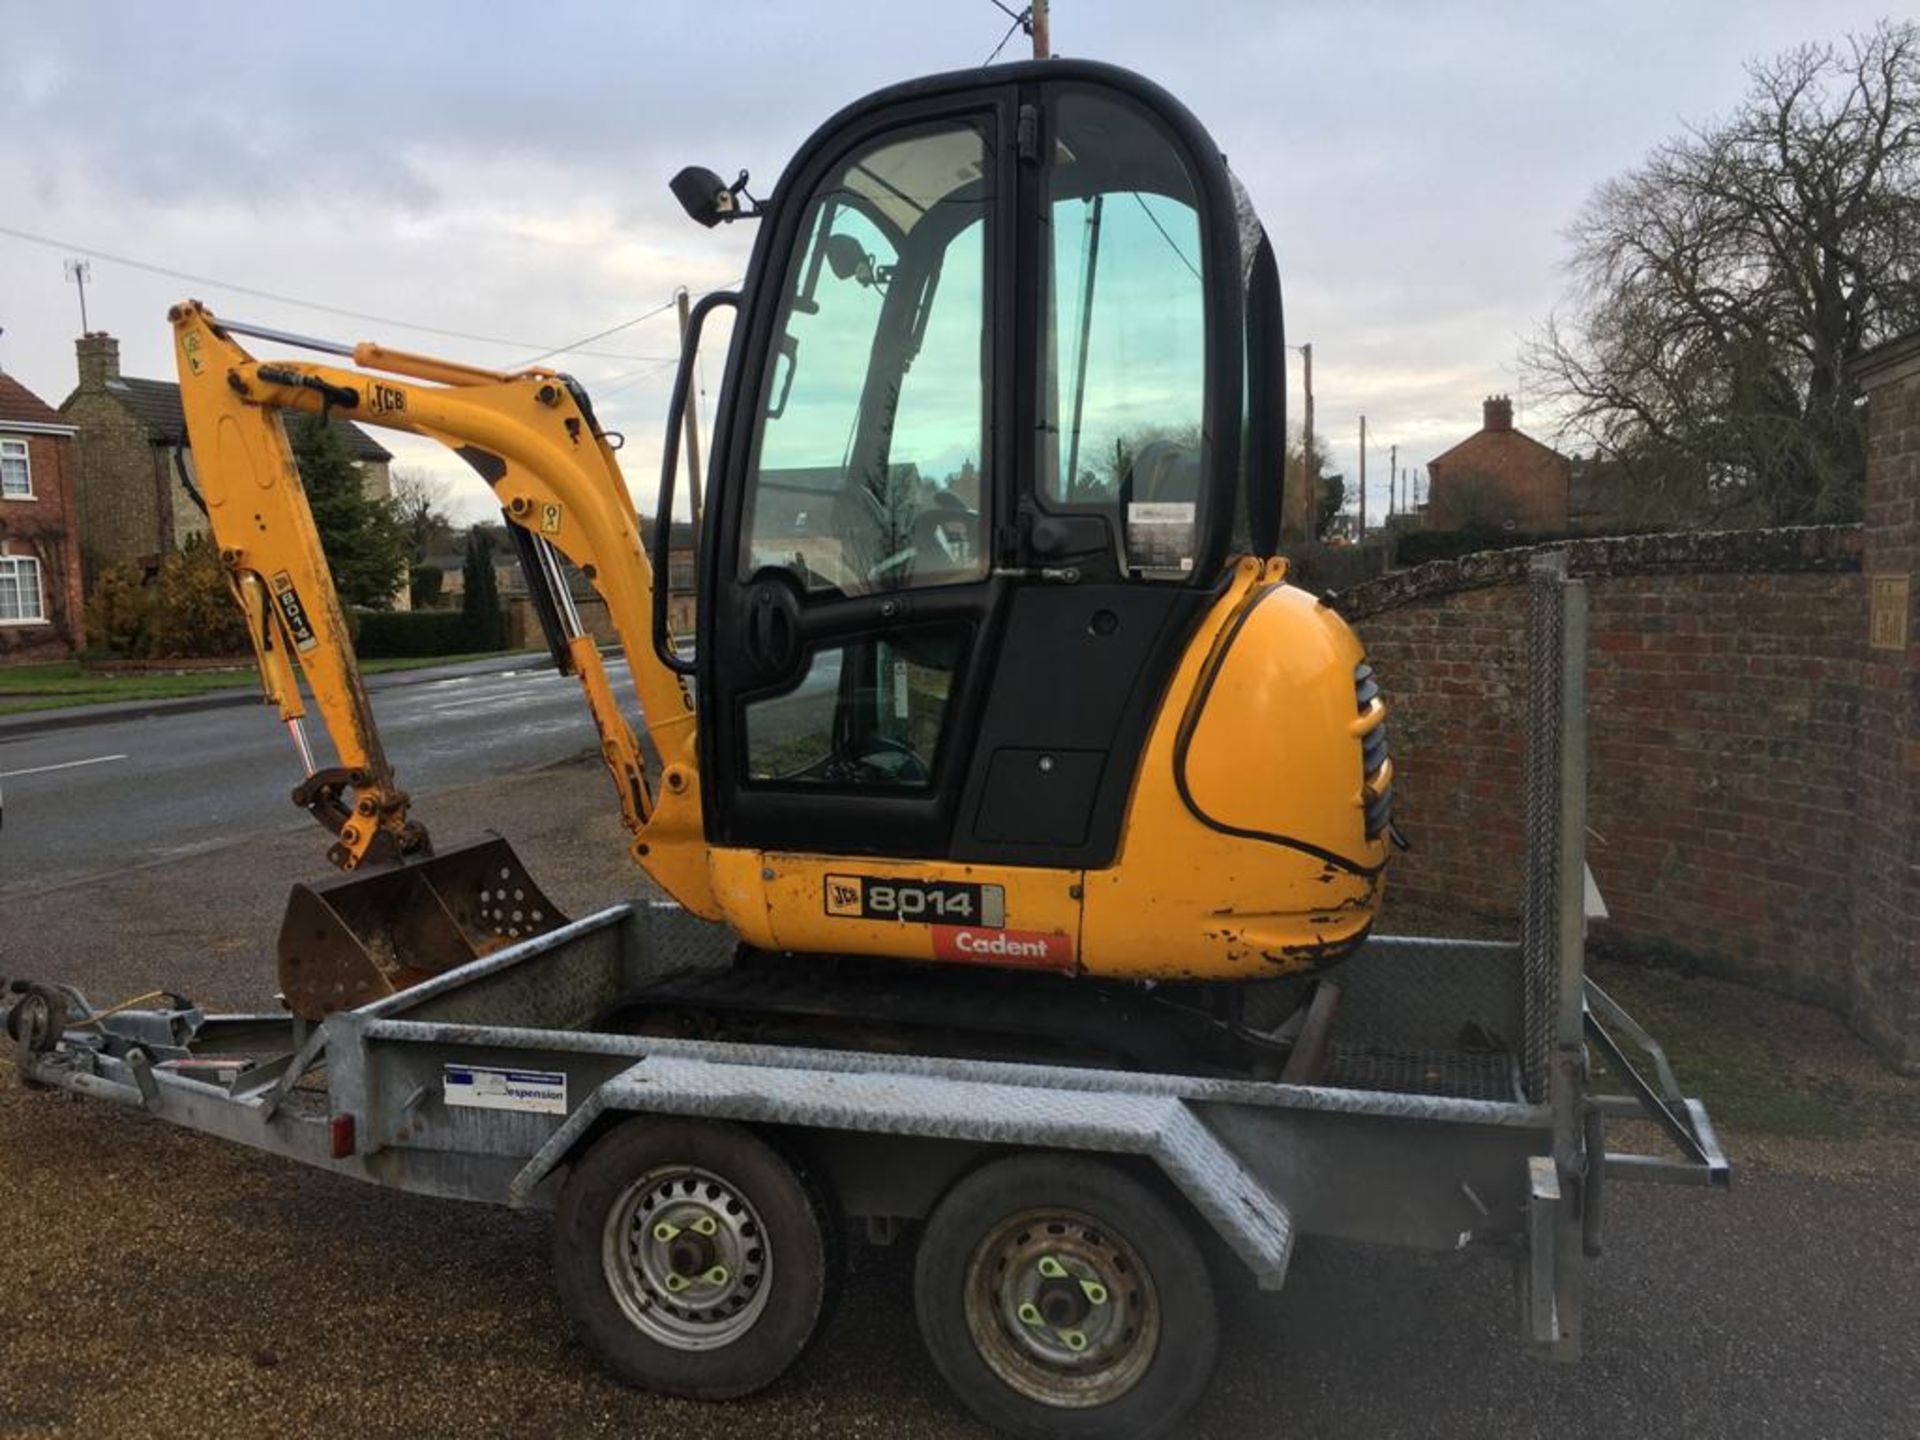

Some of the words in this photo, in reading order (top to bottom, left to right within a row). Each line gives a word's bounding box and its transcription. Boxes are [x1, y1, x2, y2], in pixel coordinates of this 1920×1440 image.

[371, 384, 405, 412] JCB
[869, 886, 973, 916] 8014
[955, 931, 1047, 957] Cadent
